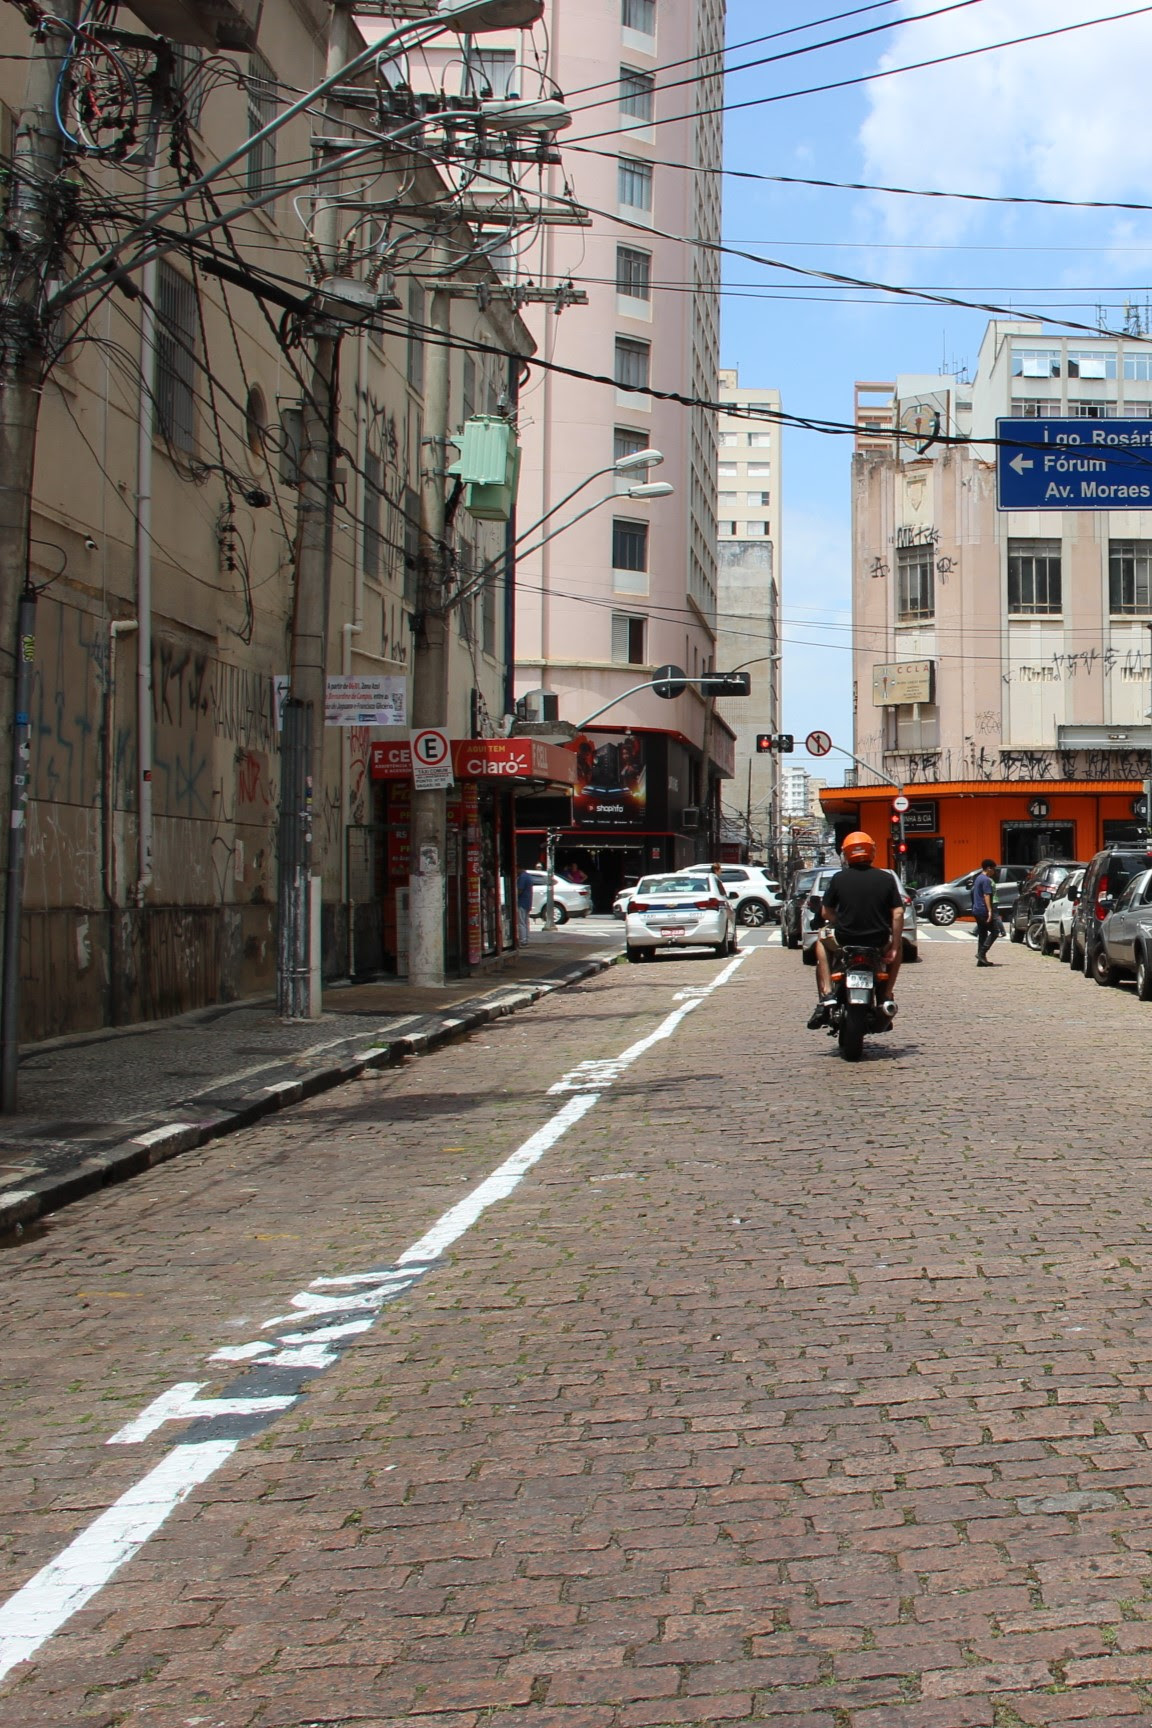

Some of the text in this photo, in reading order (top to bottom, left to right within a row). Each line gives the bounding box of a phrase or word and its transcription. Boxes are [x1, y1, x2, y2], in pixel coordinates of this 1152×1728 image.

[1044, 454, 1106, 473] Fórum
[1045, 481, 1074, 499] Av.
[1081, 481, 1151, 499] Moraes
[374, 748, 411, 763] F CE
[425, 738, 439, 759] E
[466, 744, 506, 753] AQUI TEM
[467, 758, 521, 775] Claro
